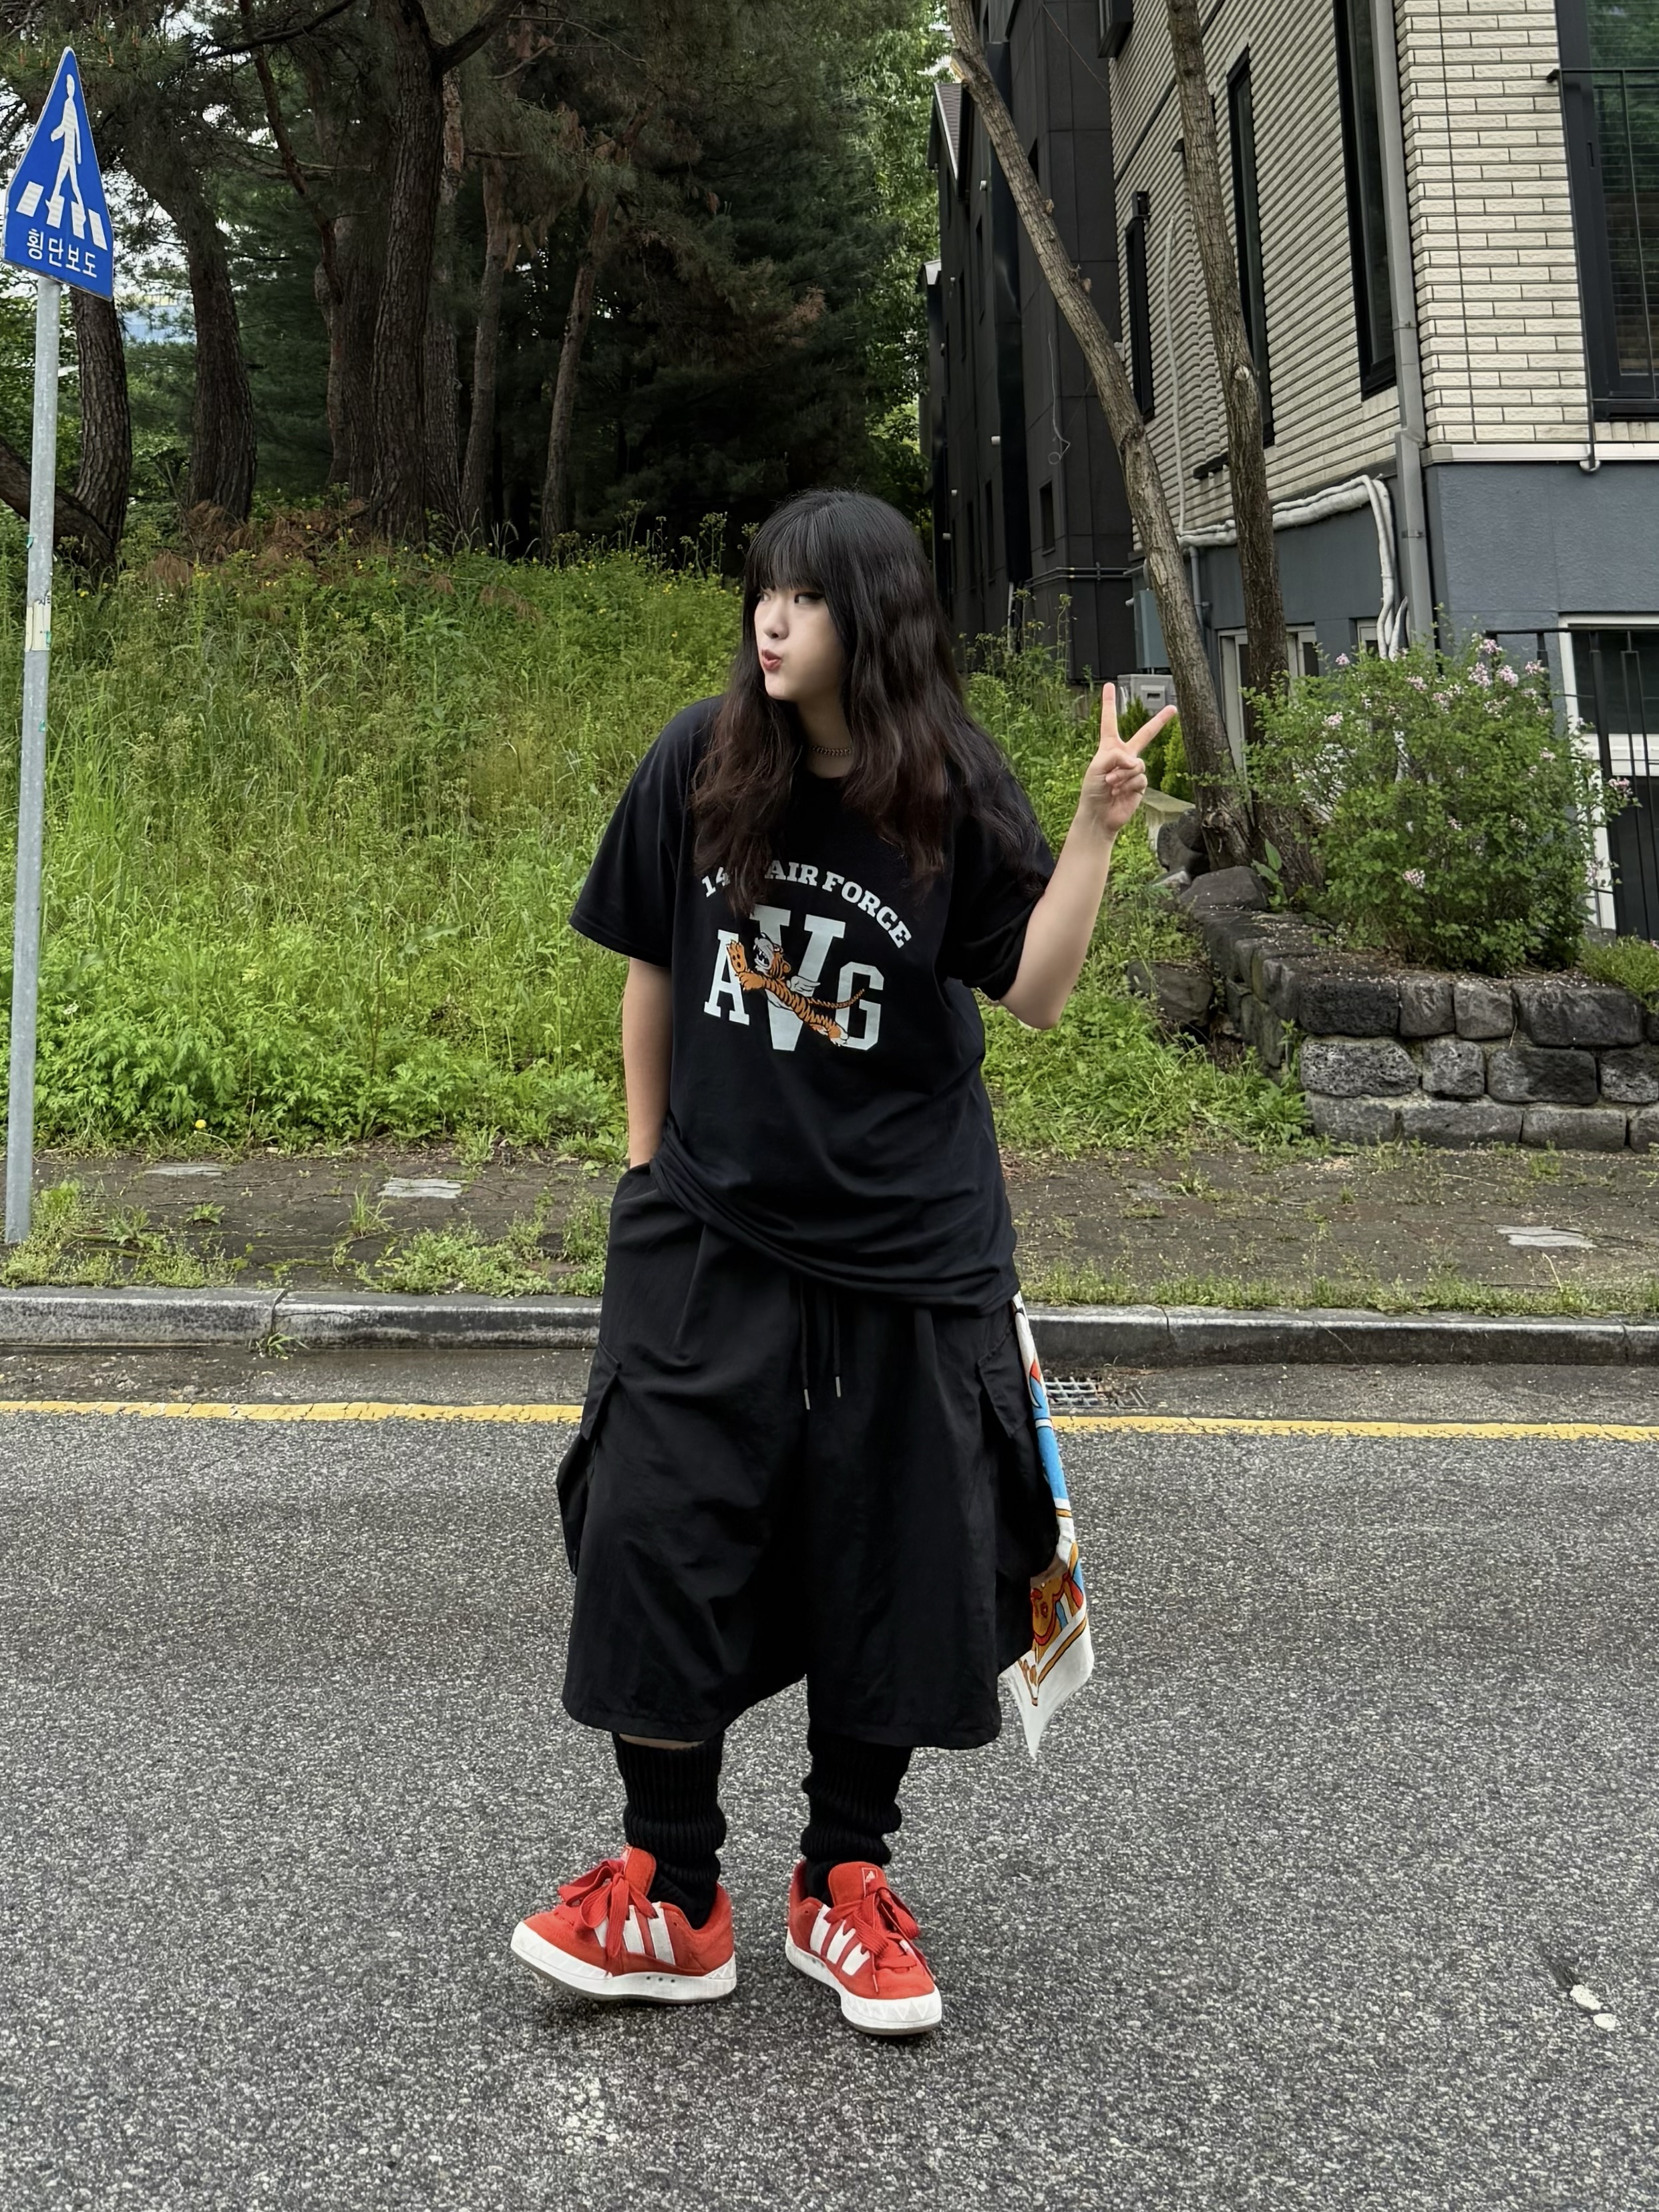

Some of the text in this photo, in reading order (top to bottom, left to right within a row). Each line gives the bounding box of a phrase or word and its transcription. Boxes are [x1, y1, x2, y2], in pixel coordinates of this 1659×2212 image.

[27, 228, 98, 278] 횡단보도
[702, 860, 912, 948] 14 AIR FORCE
[704, 904, 884, 1051] AVG
